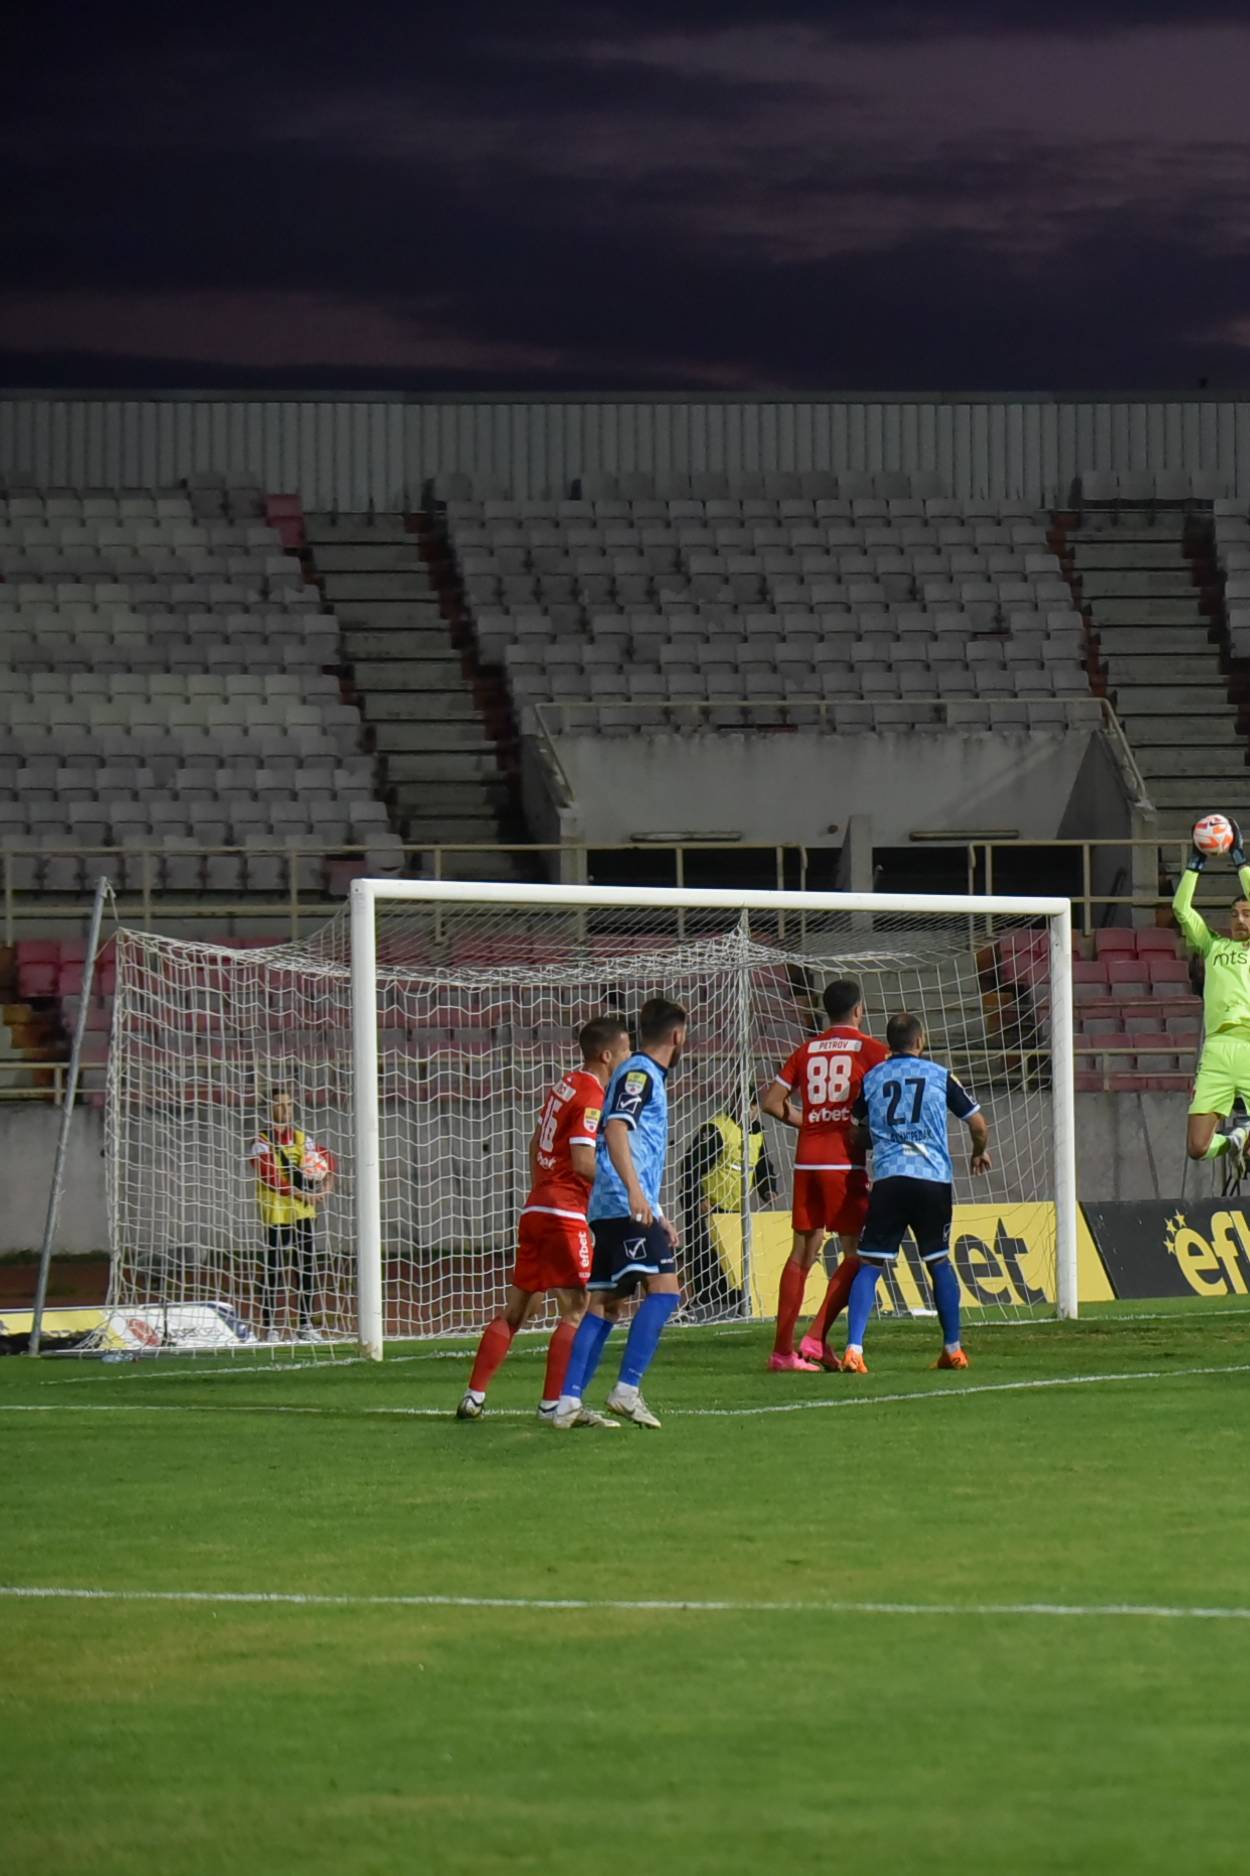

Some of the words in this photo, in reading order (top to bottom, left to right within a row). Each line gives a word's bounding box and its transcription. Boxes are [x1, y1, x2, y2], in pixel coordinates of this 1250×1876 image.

[1213, 950, 1248, 967] mts
[819, 1041, 848, 1050] PETROV
[807, 1055, 852, 1104] 88
[883, 1078, 926, 1126] 27
